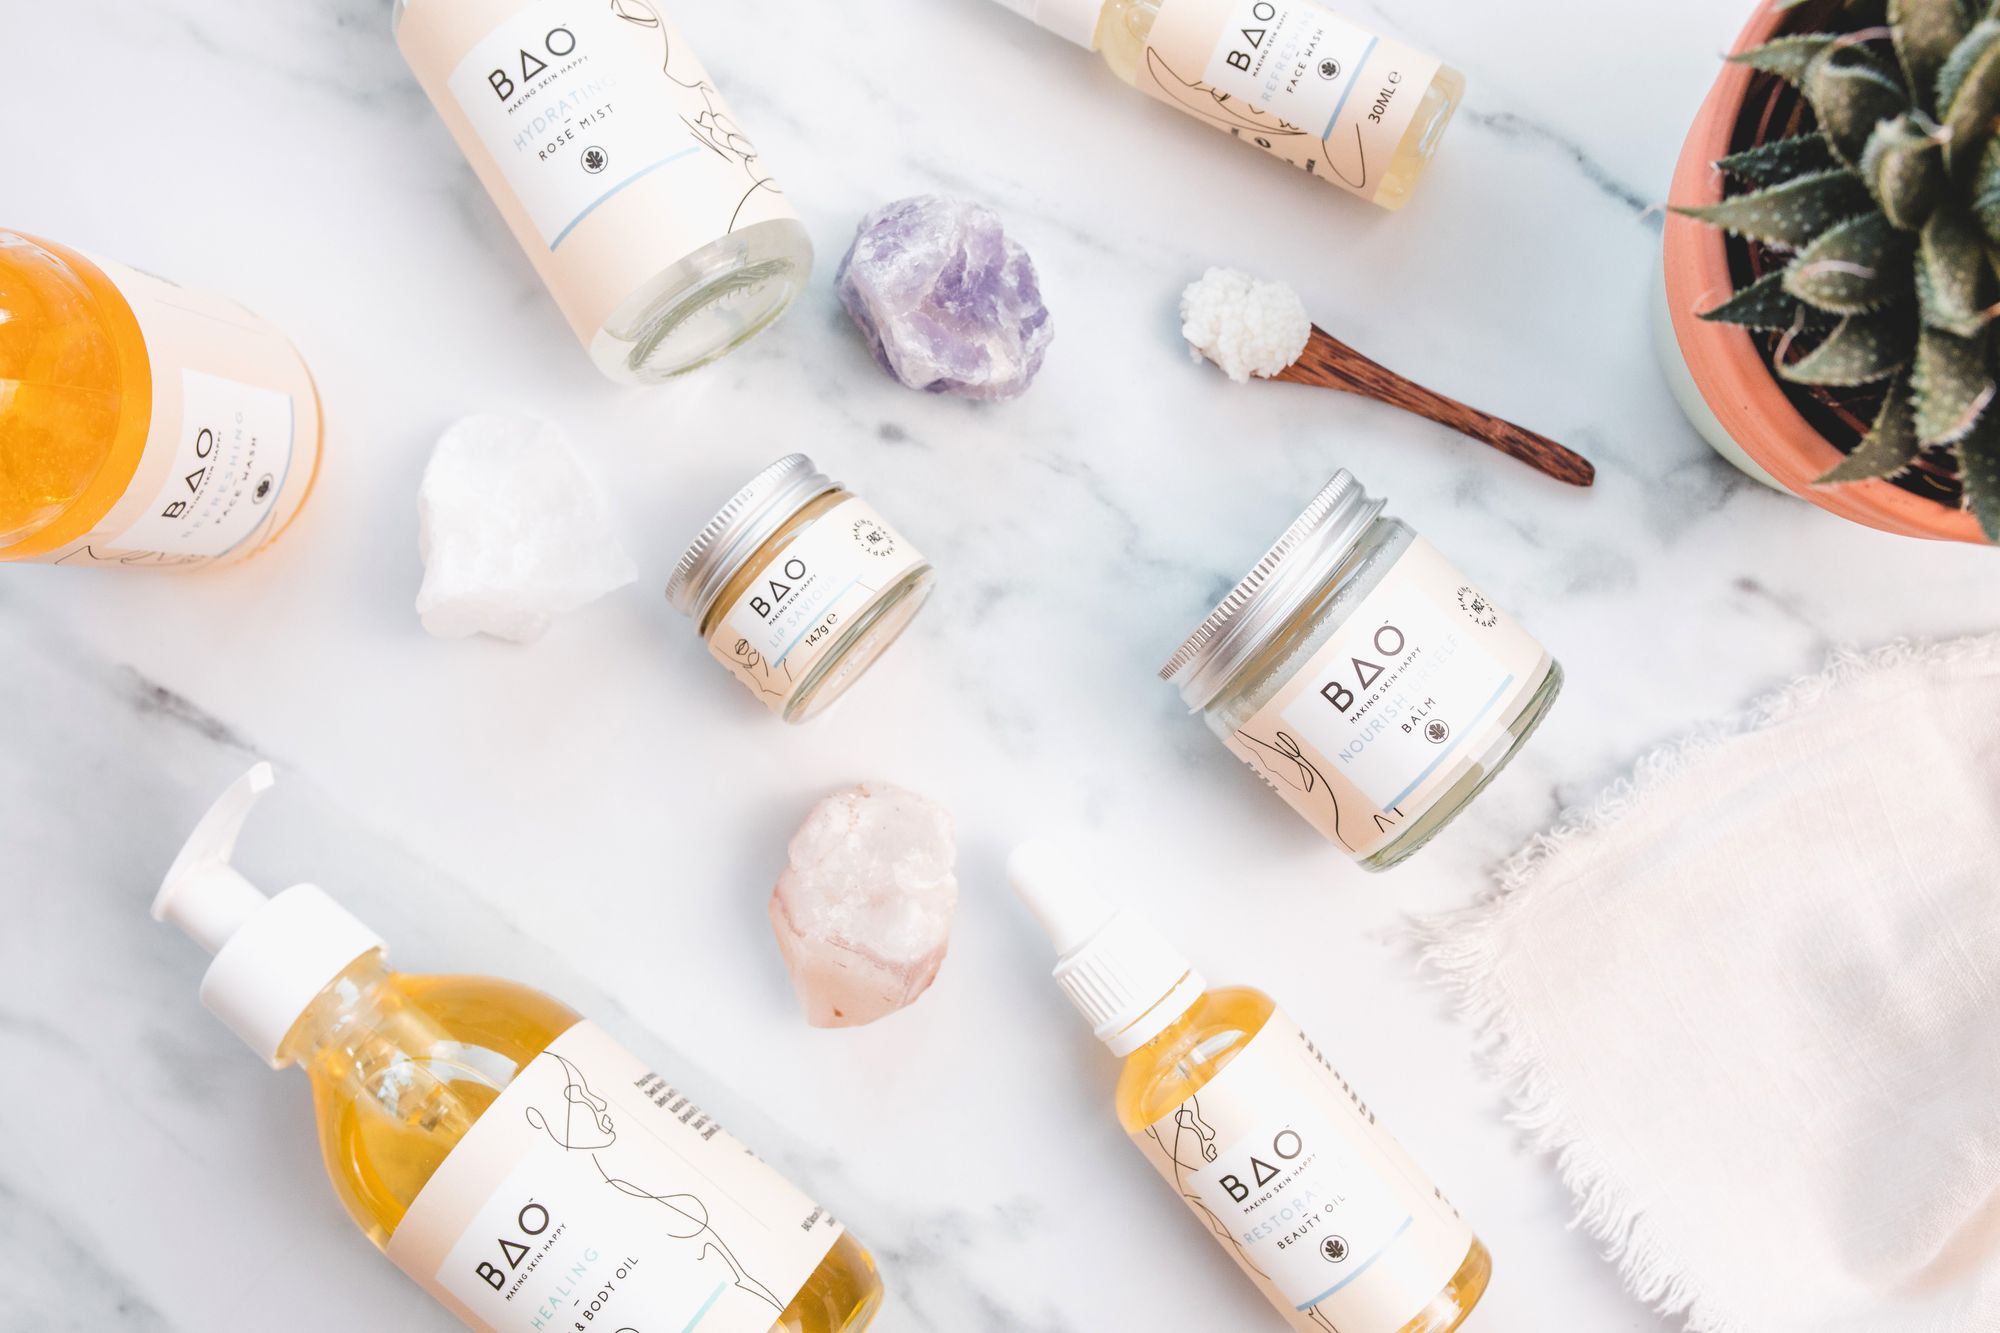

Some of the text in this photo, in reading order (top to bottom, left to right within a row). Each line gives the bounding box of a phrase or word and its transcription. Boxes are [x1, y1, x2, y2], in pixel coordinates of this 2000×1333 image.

[488, 25, 576, 102] BAO
[507, 55, 589, 115] MAKING SKIN HAPPY
[1252, 49, 1269, 78] MAKING
[1266, 31, 1277, 49] SKIN
[1286, 28, 1325, 94] FACE WASH
[512, 73, 617, 152] HYDRATING
[538, 103, 615, 162] ROSE MIST
[1368, 87, 1396, 124] 30ML
[160, 427, 213, 519] BAO
[214, 436, 258, 525] FACE WASH
[749, 556, 806, 619] BAO
[768, 574, 817, 626] MAKING SKIN HAPPY
[768, 626, 785, 649] LIP
[804, 625, 830, 648] 14.7g
[1320, 622, 1405, 714] BAO
[1349, 646, 1422, 725] MAKING SKIN HAPPY
[1401, 696, 1436, 733] BALM
[1338, 692, 1409, 764] NOURISH
[1218, 1127, 1303, 1204] BAO
[1243, 1152, 1318, 1215] MAKING SKIN HAPPY
[475, 1200, 550, 1291] BAO
[1276, 1194, 1346, 1250] BEAUTY OIL
[505, 1223, 567, 1302] MAKING SKIN HAPPY
[530, 1248, 599, 1331] HEALING
[574, 1257, 639, 1332] & BODY OIL
